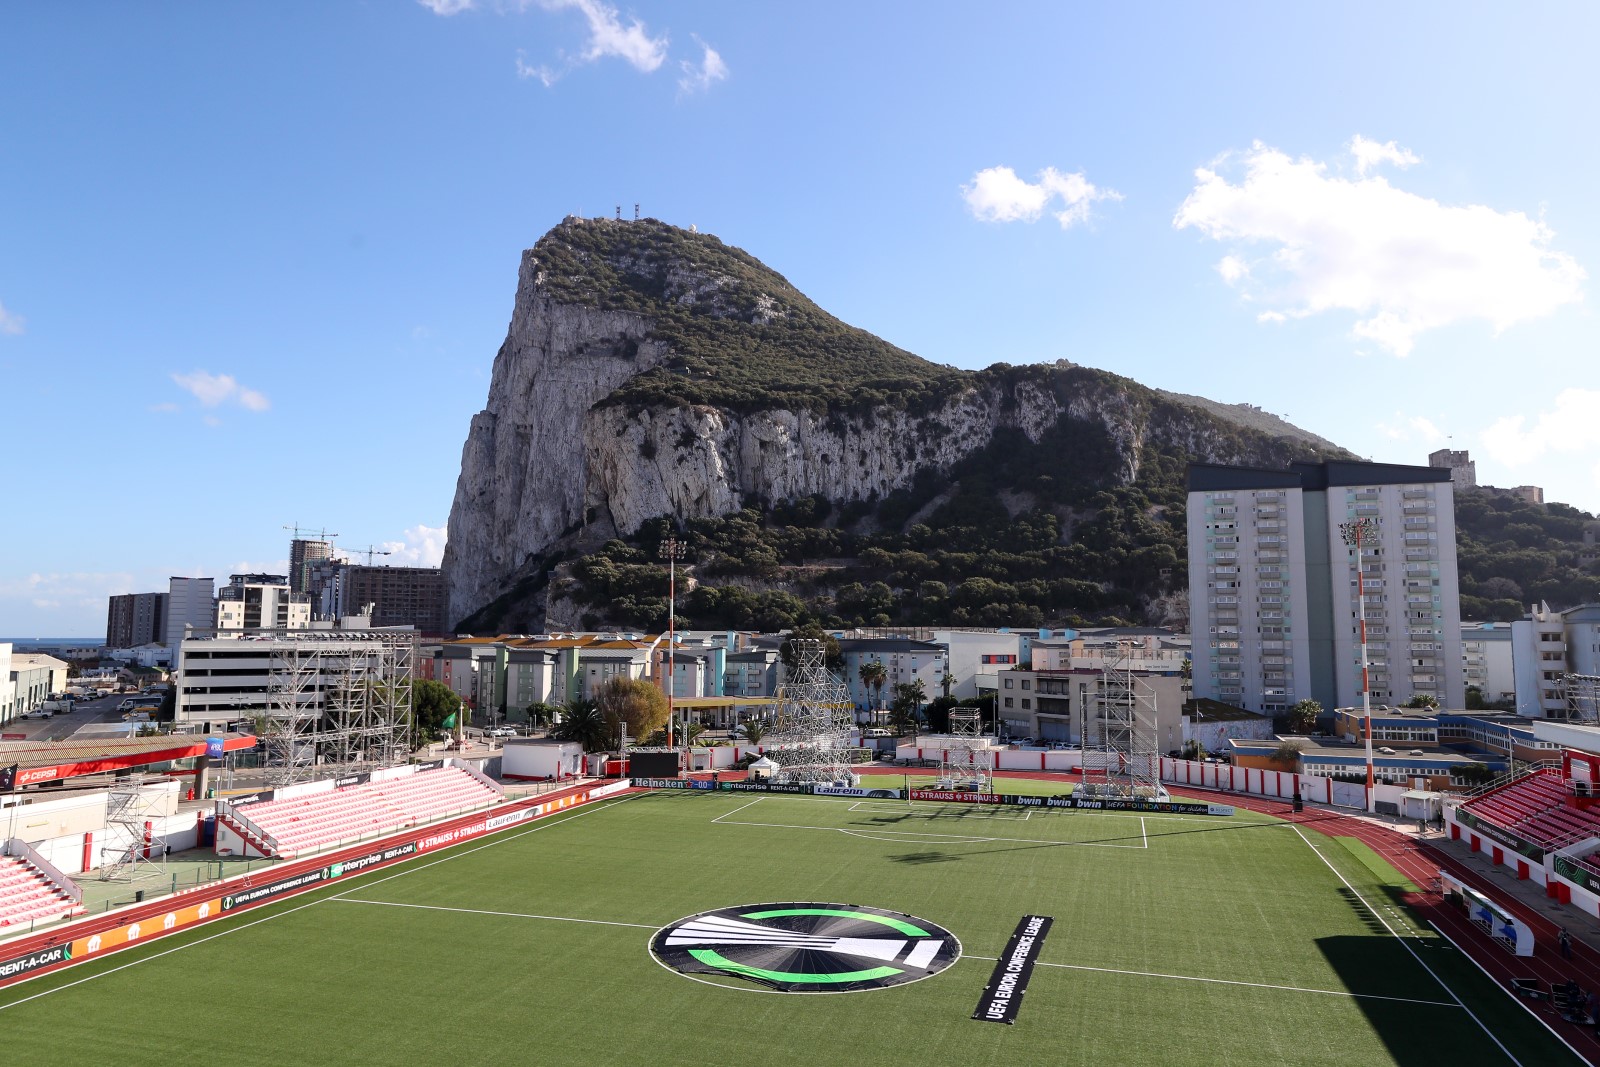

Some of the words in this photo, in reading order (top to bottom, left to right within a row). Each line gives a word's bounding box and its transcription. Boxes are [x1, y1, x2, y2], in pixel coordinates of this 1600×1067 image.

[31, 769, 57, 780] CEPSA
[635, 777, 684, 788] Heineken
[723, 782, 767, 791] enterprise
[919, 792, 954, 800] STRAUSS
[963, 793, 999, 802] STRAUSS
[1017, 796, 1042, 805] bwin
[1046, 797, 1072, 807] bwin
[1076, 798, 1102, 808] bwin
[1126, 802, 1177, 811] FOUNDATION
[425, 832, 454, 848] STRAUSS
[460, 823, 485, 837] STRAUSS
[332, 854, 382, 874] enterprise
[384, 845, 413, 859] RENT-A-CAR
[235, 894, 250, 904] UEFA
[250, 889, 270, 899] EUROPA
[270, 878, 302, 893] CONFERENCE
[302, 872, 321, 883] LEAGUE
[1023, 916, 1045, 936] LEAGUE
[0, 950, 62, 977] RENT-A-CAR
[1006, 936, 1035, 972] CONFERENCE
[995, 973, 1020, 999] EUROPA
[986, 999, 1009, 1019] UEFA
